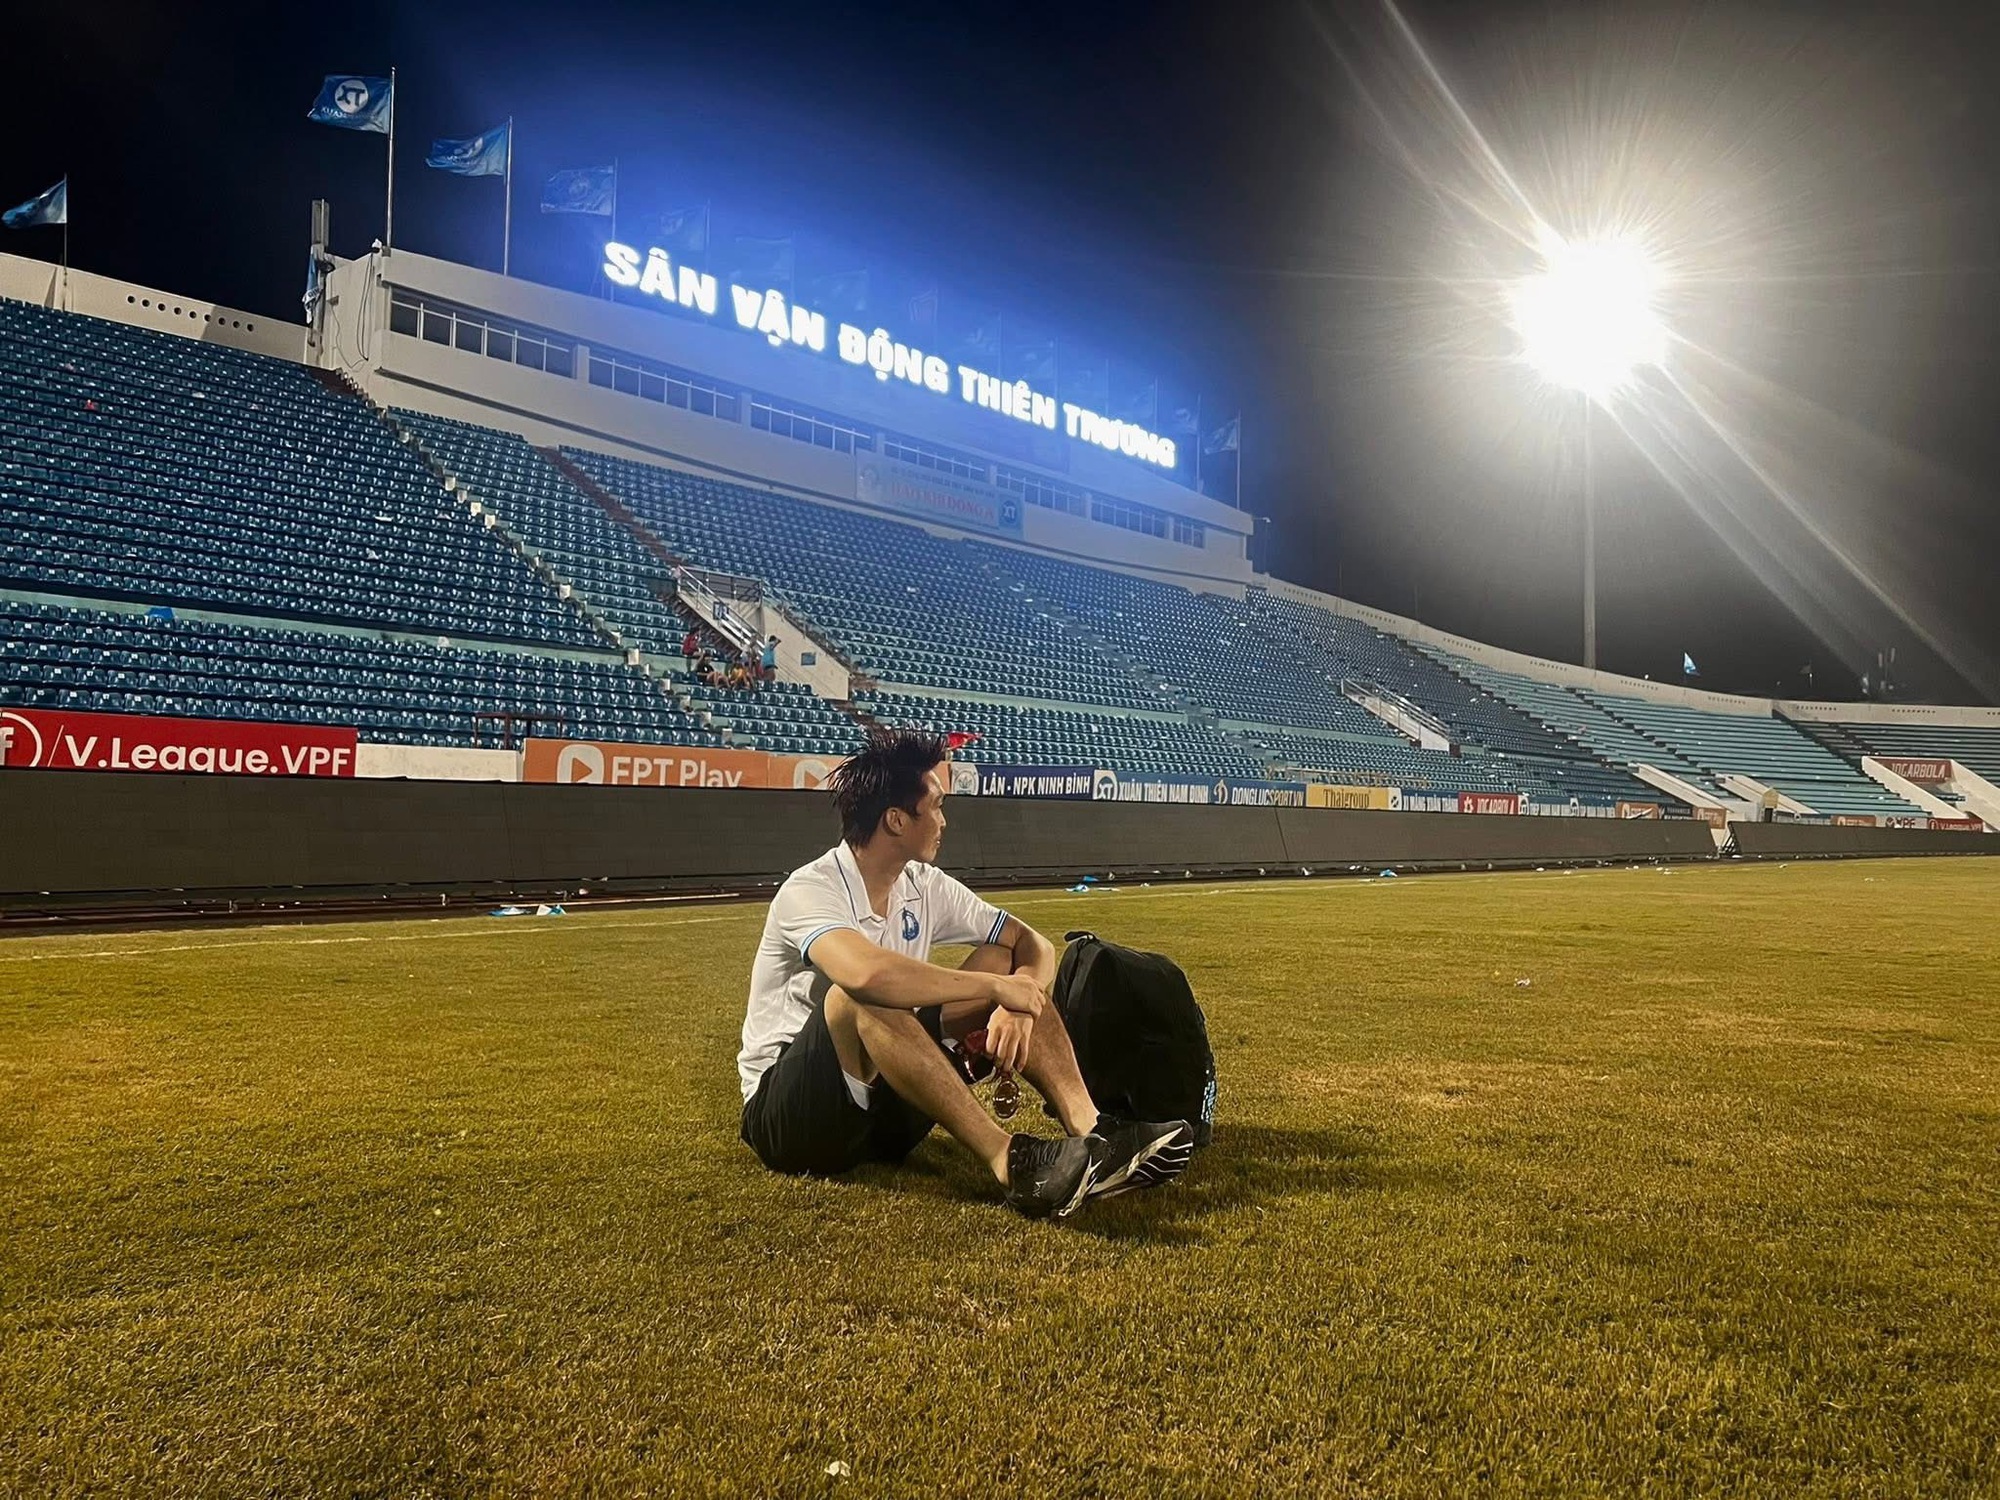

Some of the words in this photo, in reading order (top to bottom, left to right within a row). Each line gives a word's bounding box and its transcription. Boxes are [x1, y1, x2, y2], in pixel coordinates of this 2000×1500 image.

[603, 241, 718, 316] SÂN
[731, 288, 826, 352] VẬN
[838, 322, 950, 394] ĐỘNG
[957, 364, 1057, 430] THIÊN
[612, 756, 674, 785] FPT
[982, 772, 1006, 796] LÂN
[1013, 776, 1036, 796] NPK
[1037, 776, 1064, 795] NINH
[1065, 772, 1091, 795] BÌNH
